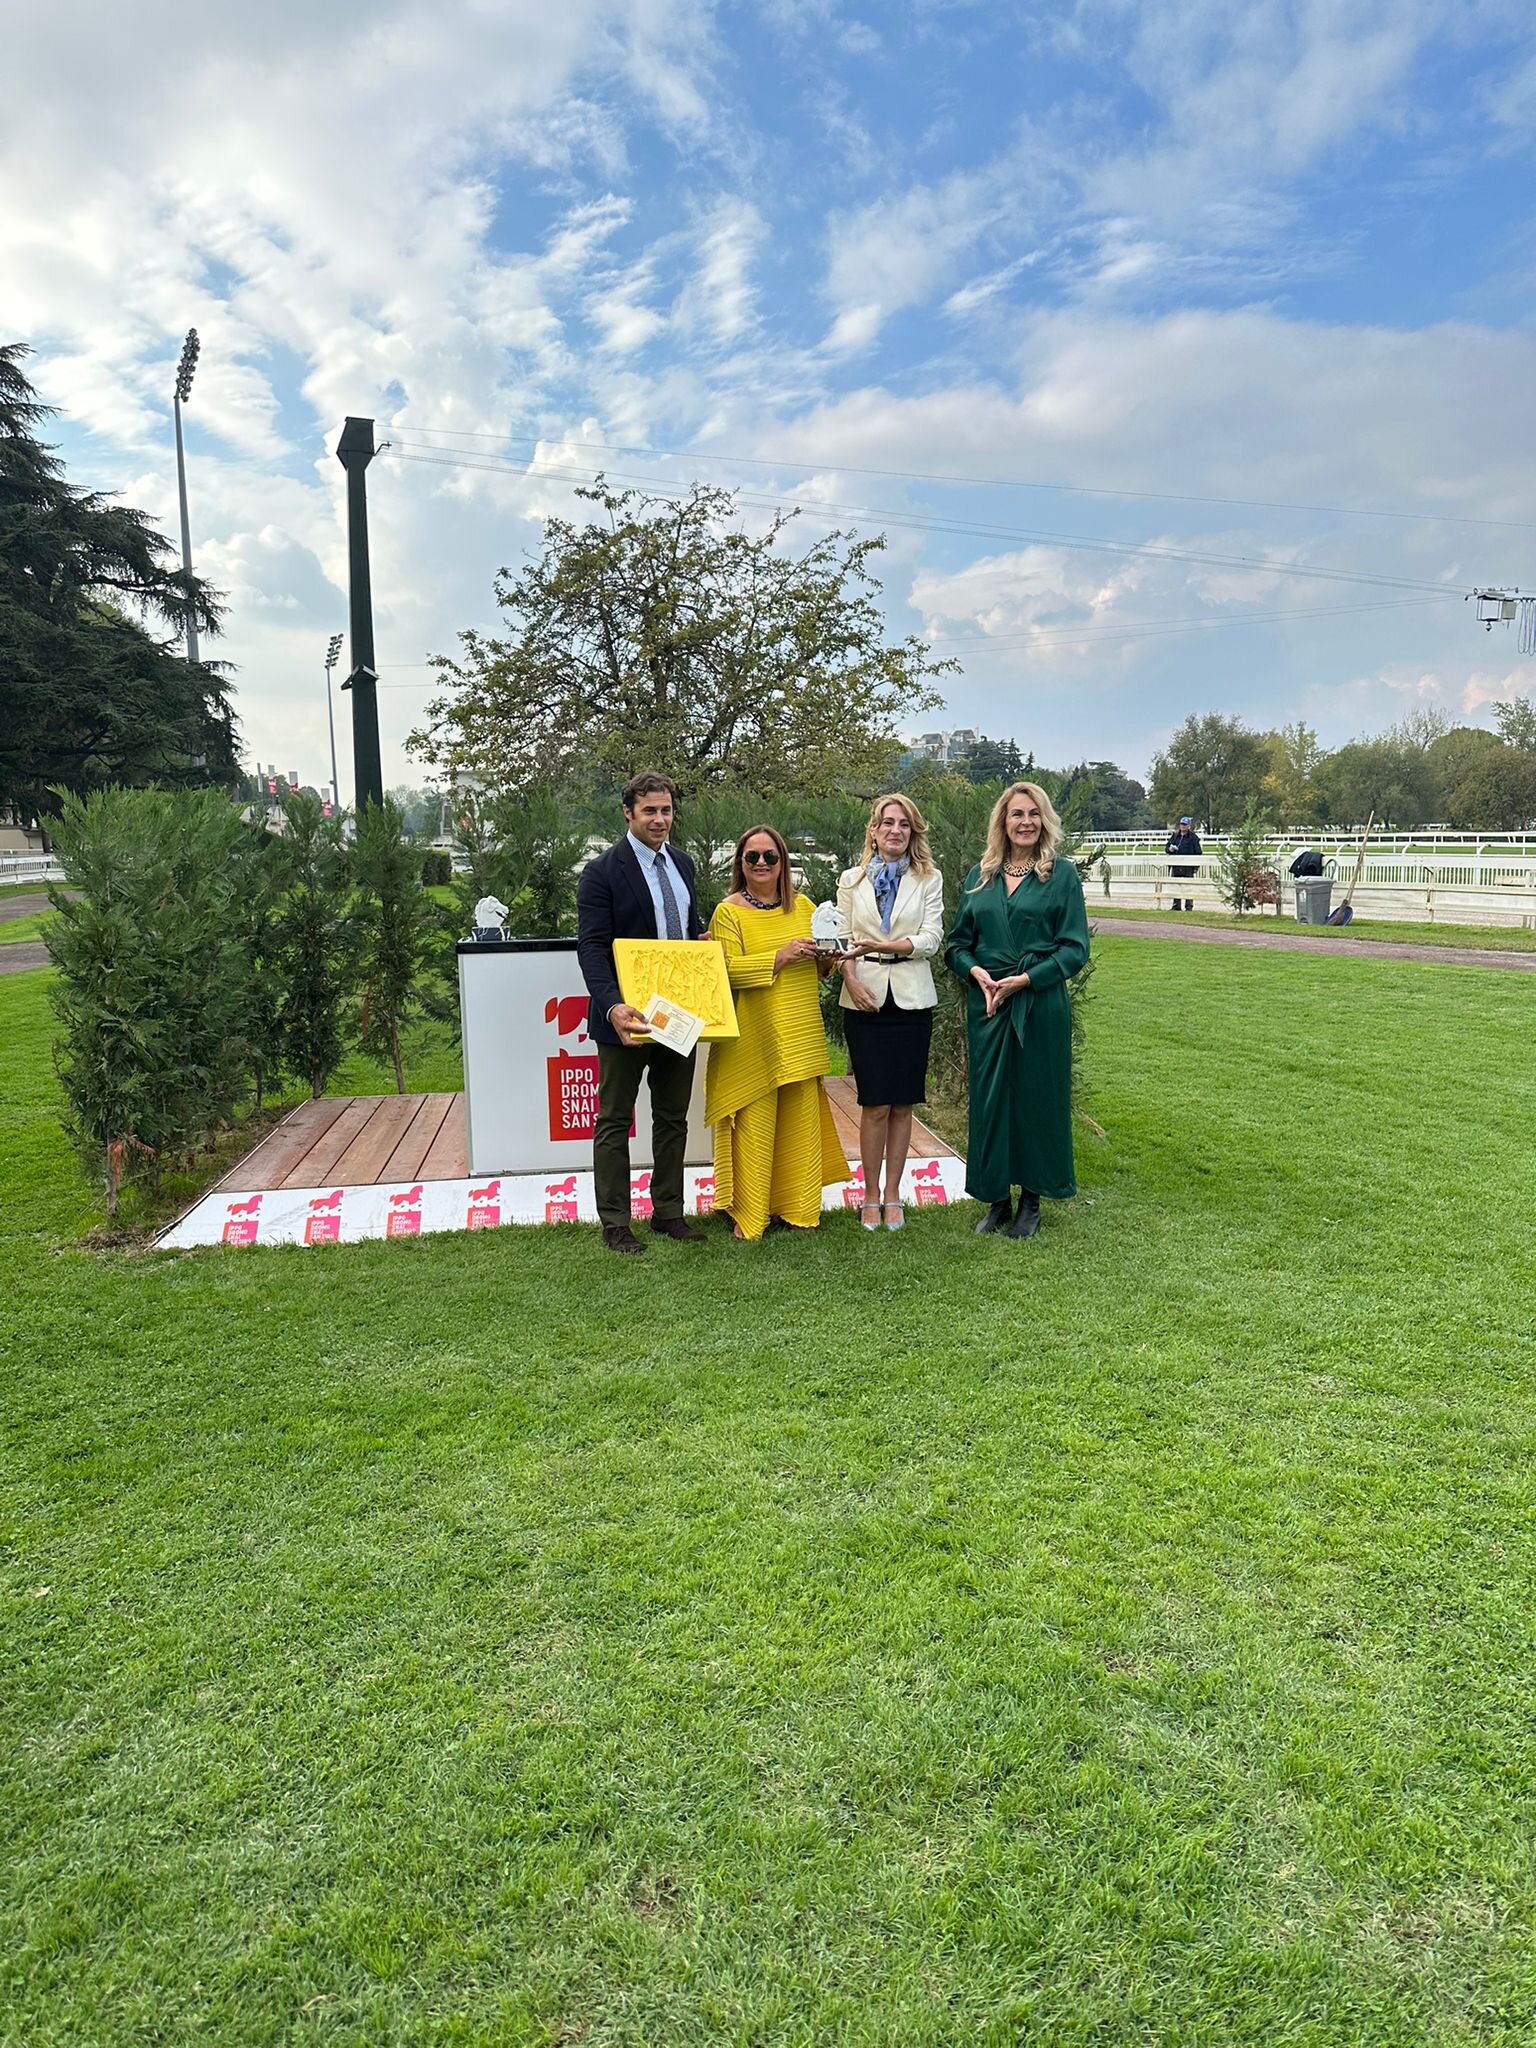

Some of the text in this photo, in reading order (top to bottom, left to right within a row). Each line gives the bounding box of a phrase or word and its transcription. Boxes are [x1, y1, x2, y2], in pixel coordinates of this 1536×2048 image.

[561, 1068, 593, 1083] IPPO
[561, 1098, 594, 1114] SNAI
[562, 1113, 590, 1129] SAN
